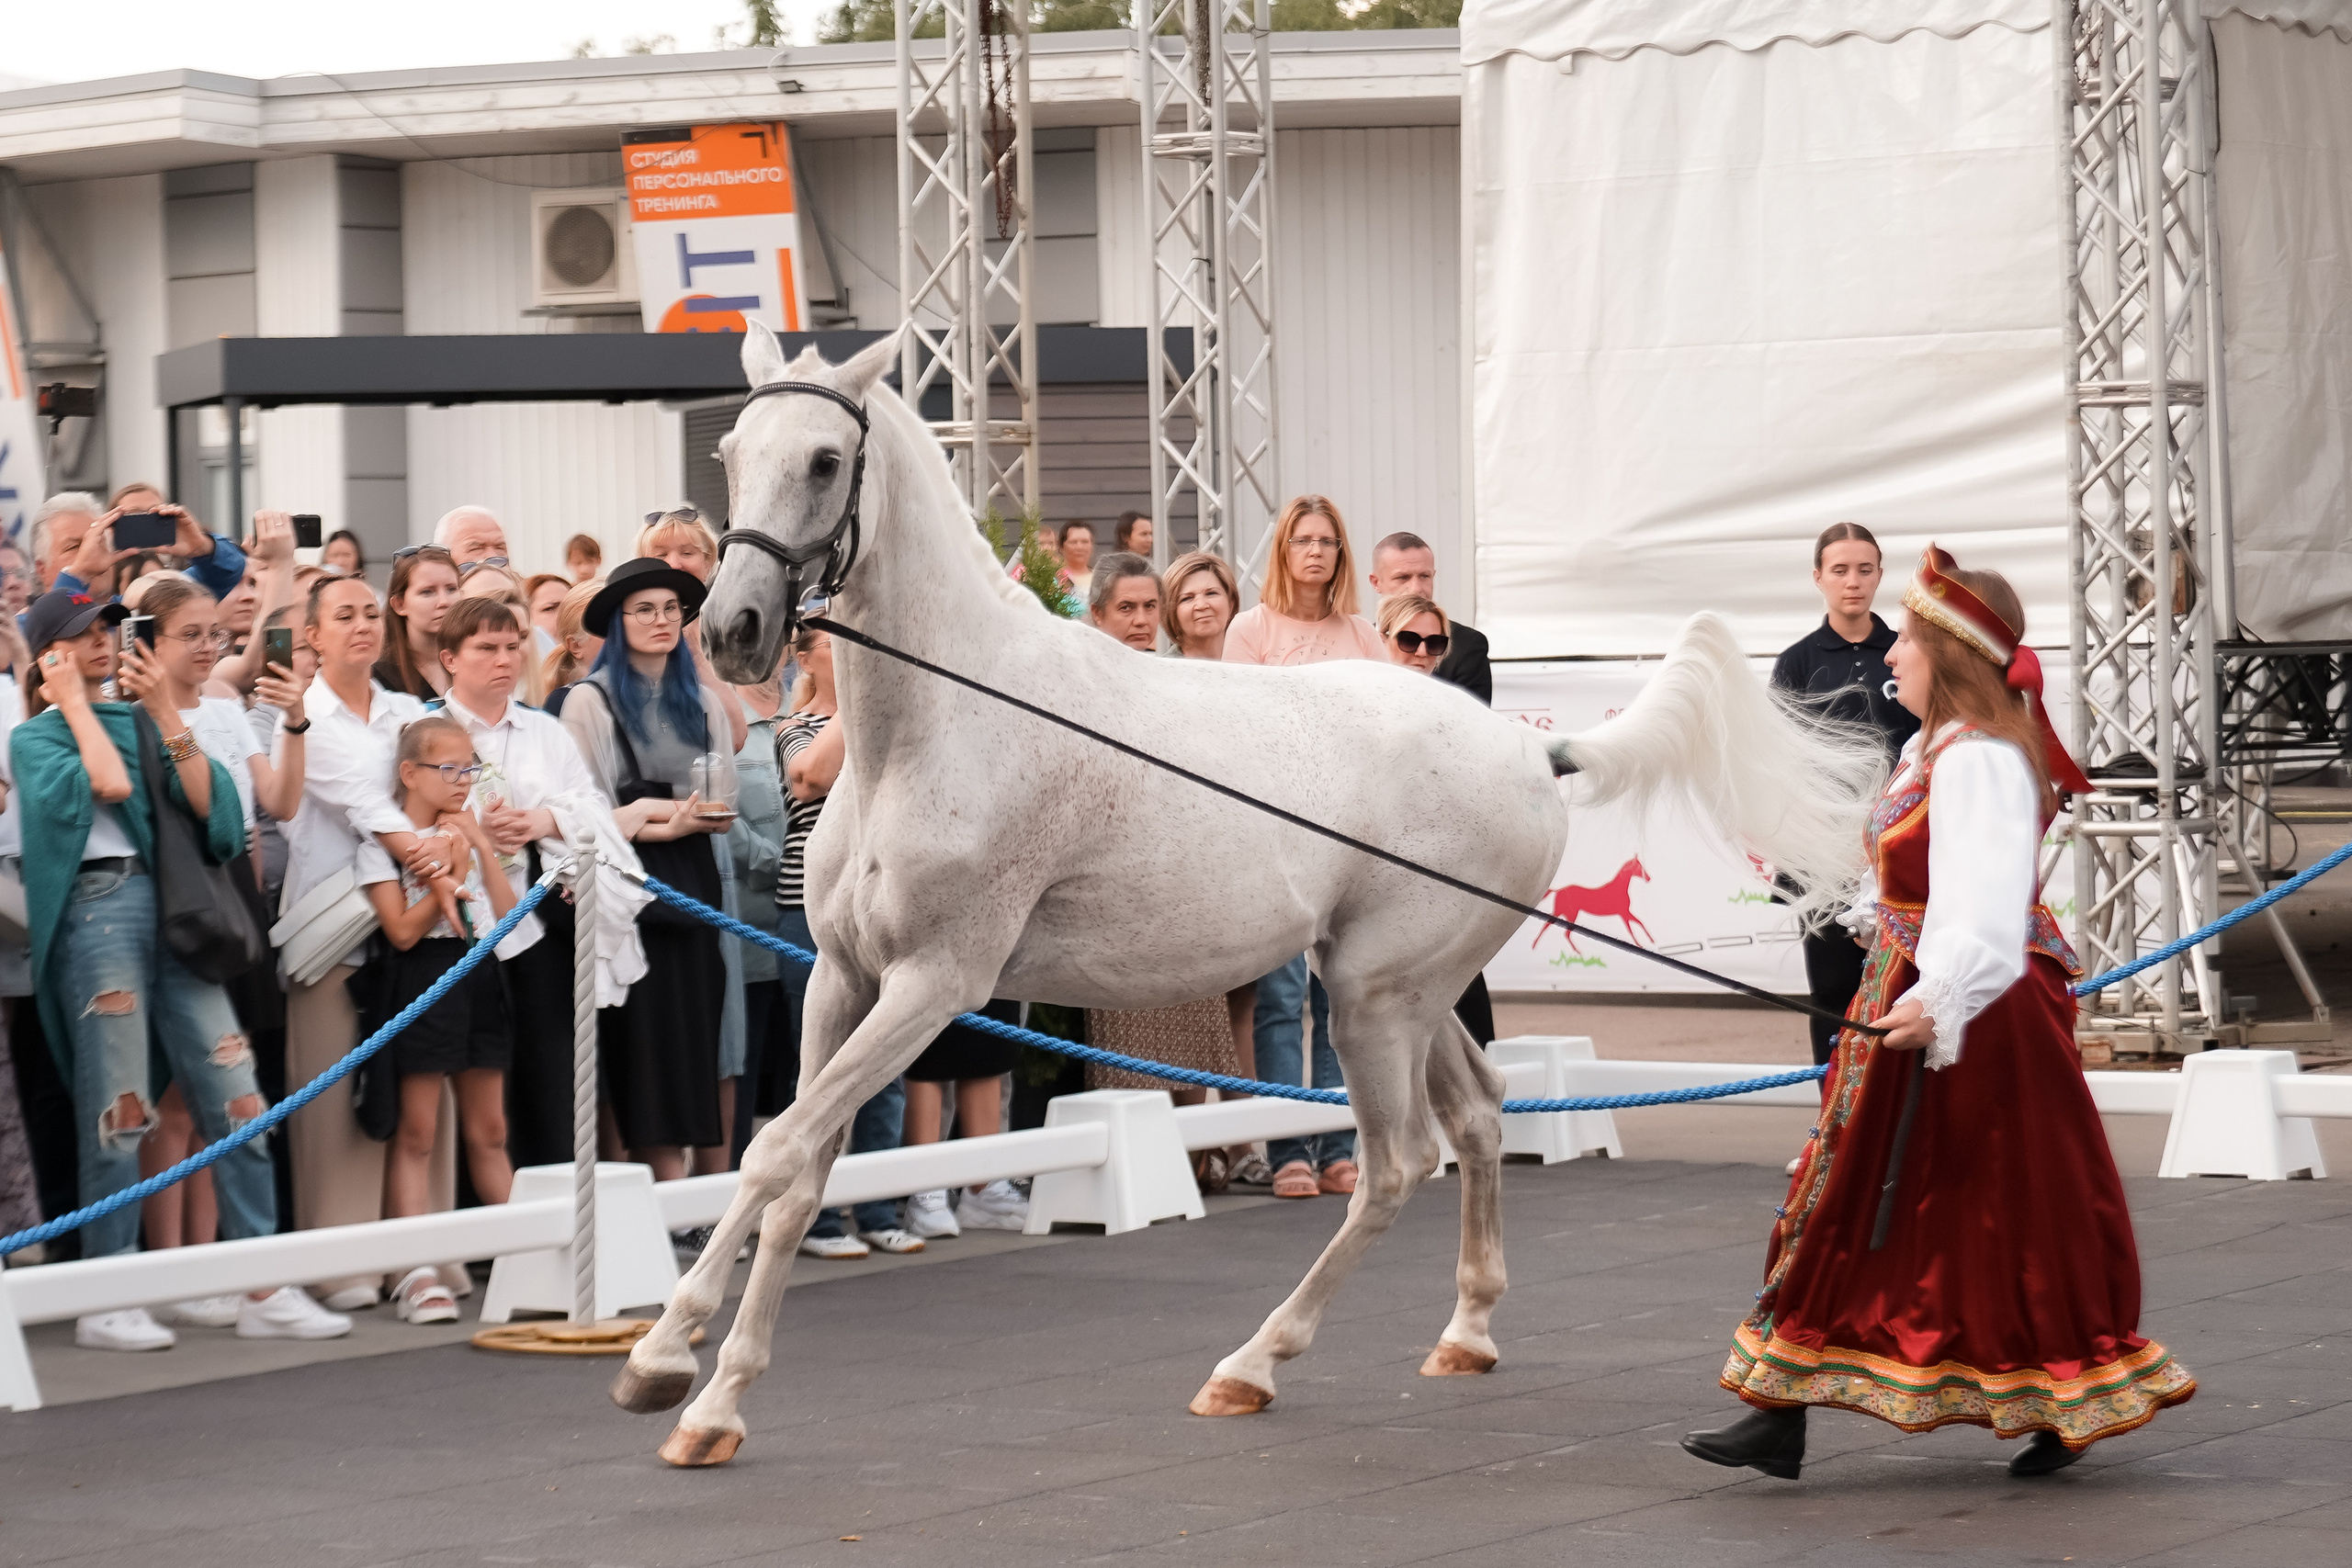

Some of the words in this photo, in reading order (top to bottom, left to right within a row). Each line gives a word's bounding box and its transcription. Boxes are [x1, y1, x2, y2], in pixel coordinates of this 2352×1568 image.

[630, 149, 698, 168] СТУДИЯ
[633, 167, 784, 190] ПЕРСОНАЛЬНОГО
[635, 195, 718, 213] ТРЕНИНГА
